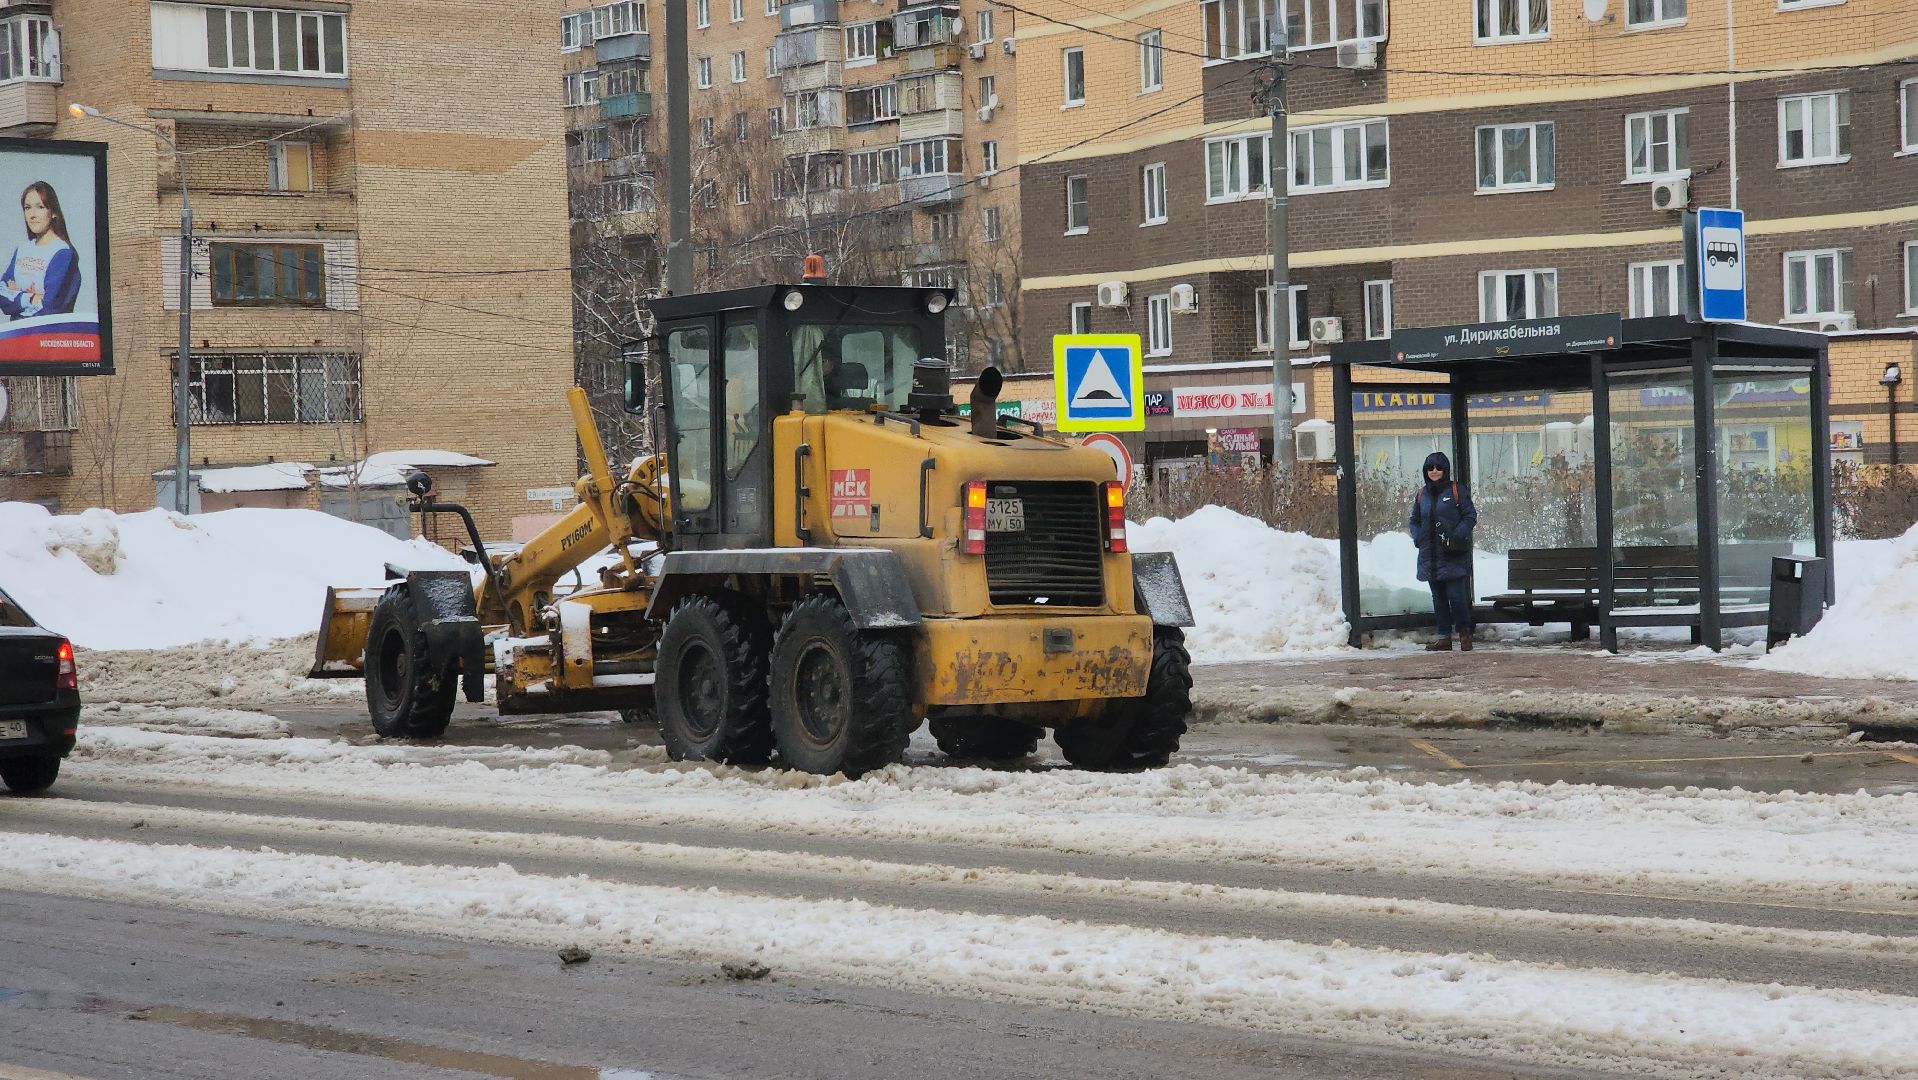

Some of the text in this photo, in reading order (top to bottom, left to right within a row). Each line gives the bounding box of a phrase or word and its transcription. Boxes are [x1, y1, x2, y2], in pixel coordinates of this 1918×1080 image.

[1444, 323, 1561, 346] ул. Дирижабельная
[73, 339, 95, 348] ОБЛАСТЬ
[1144, 393, 1163, 406] ПАР
[1177, 393, 1237, 411] МЯСО
[989, 500, 1020, 514] 3125
[1009, 518, 1022, 530] 50
